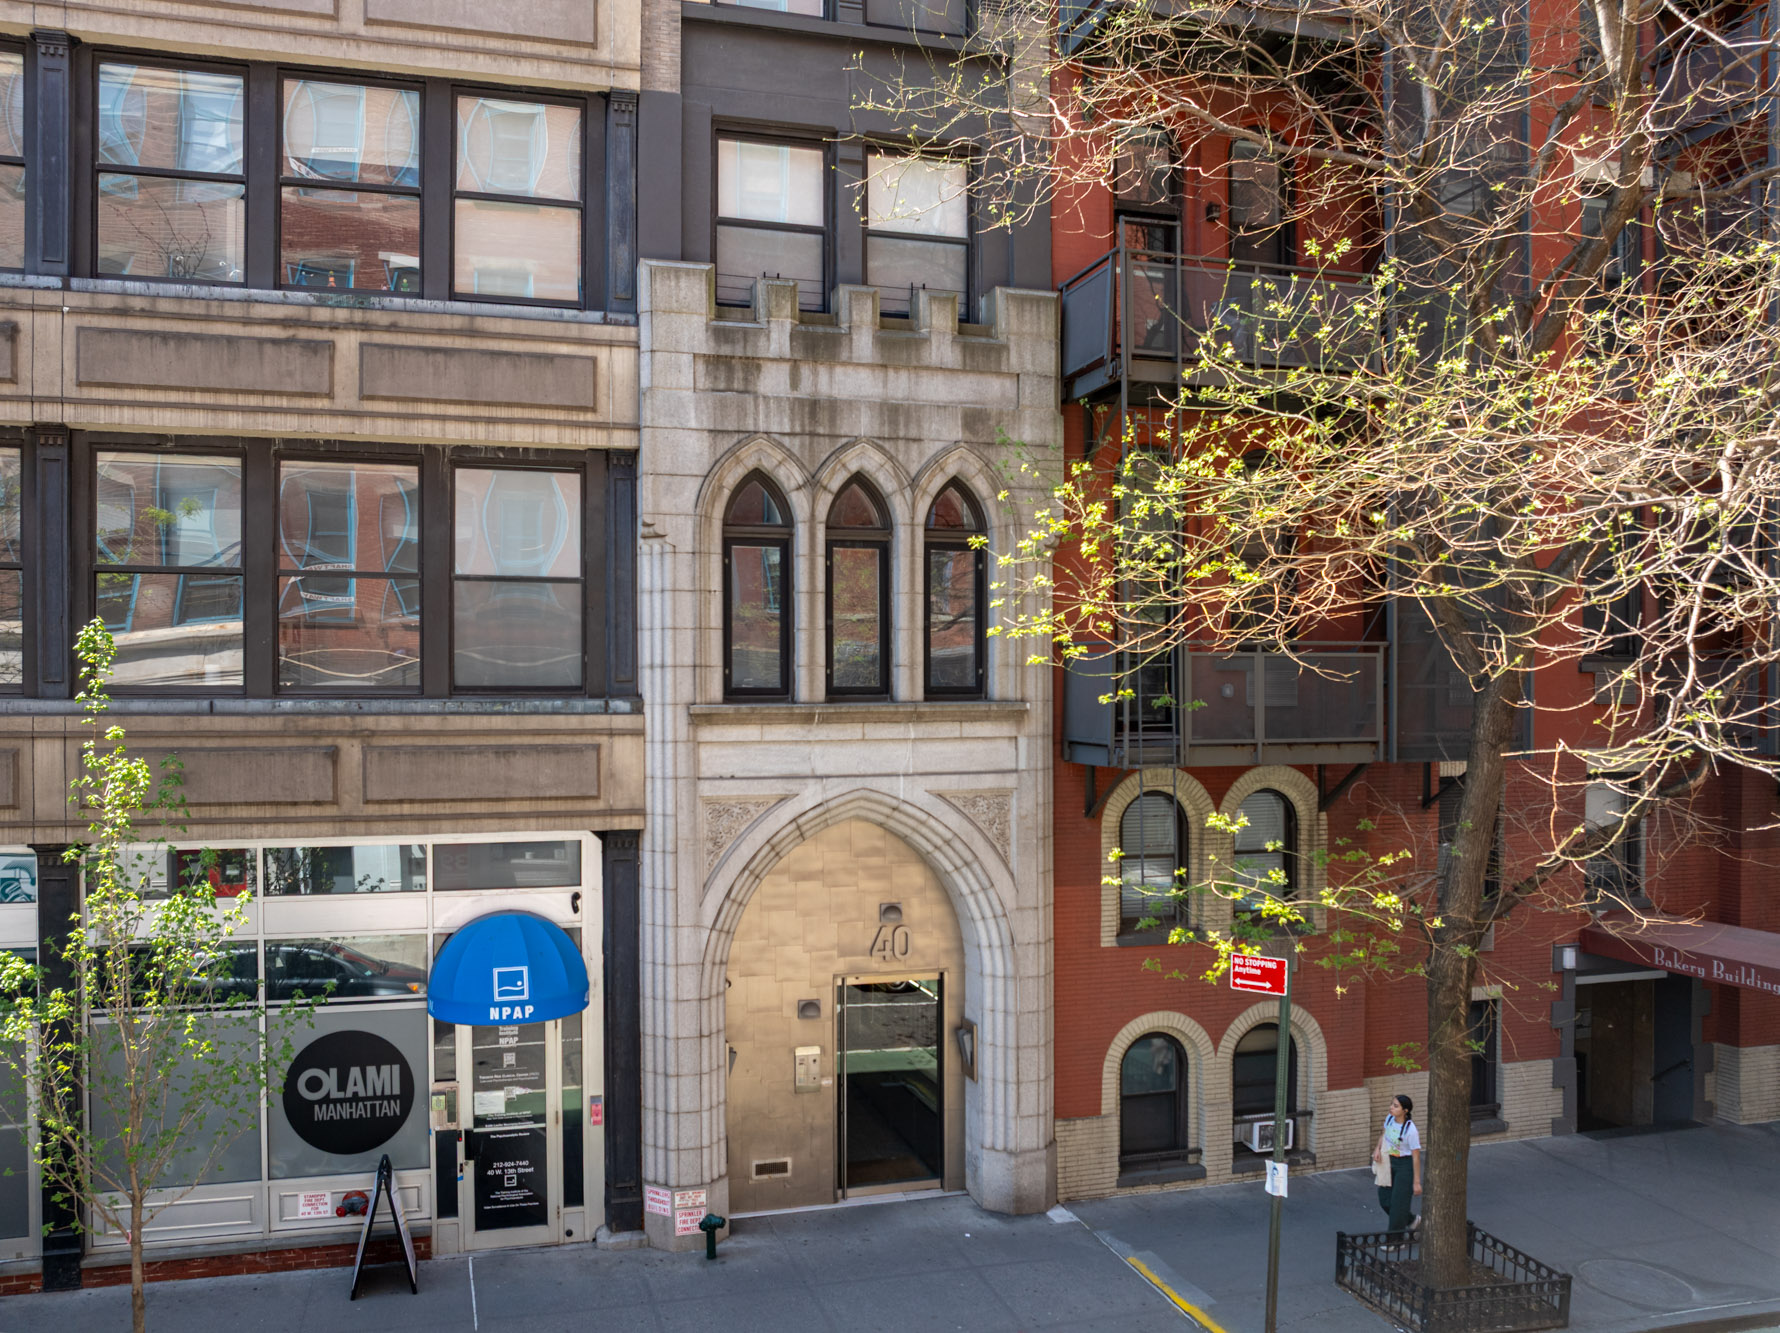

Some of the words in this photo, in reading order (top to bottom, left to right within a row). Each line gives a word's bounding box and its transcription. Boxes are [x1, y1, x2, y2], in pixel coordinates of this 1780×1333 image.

[869, 924, 913, 962] 40
[1234, 957, 1244, 965] NO
[1245, 958, 1277, 969] STOPPING
[1234, 965, 1261, 975] Anytime
[1654, 947, 1705, 978] Bakery
[1712, 959, 1780, 995] Building
[490, 1005, 534, 1020] NPAP
[499, 1036, 519, 1046] NPAP
[297, 1064, 400, 1101] OLAMI
[314, 1099, 400, 1121] MANHATTAN
[679, 1210, 702, 1218] SPRINKLER
